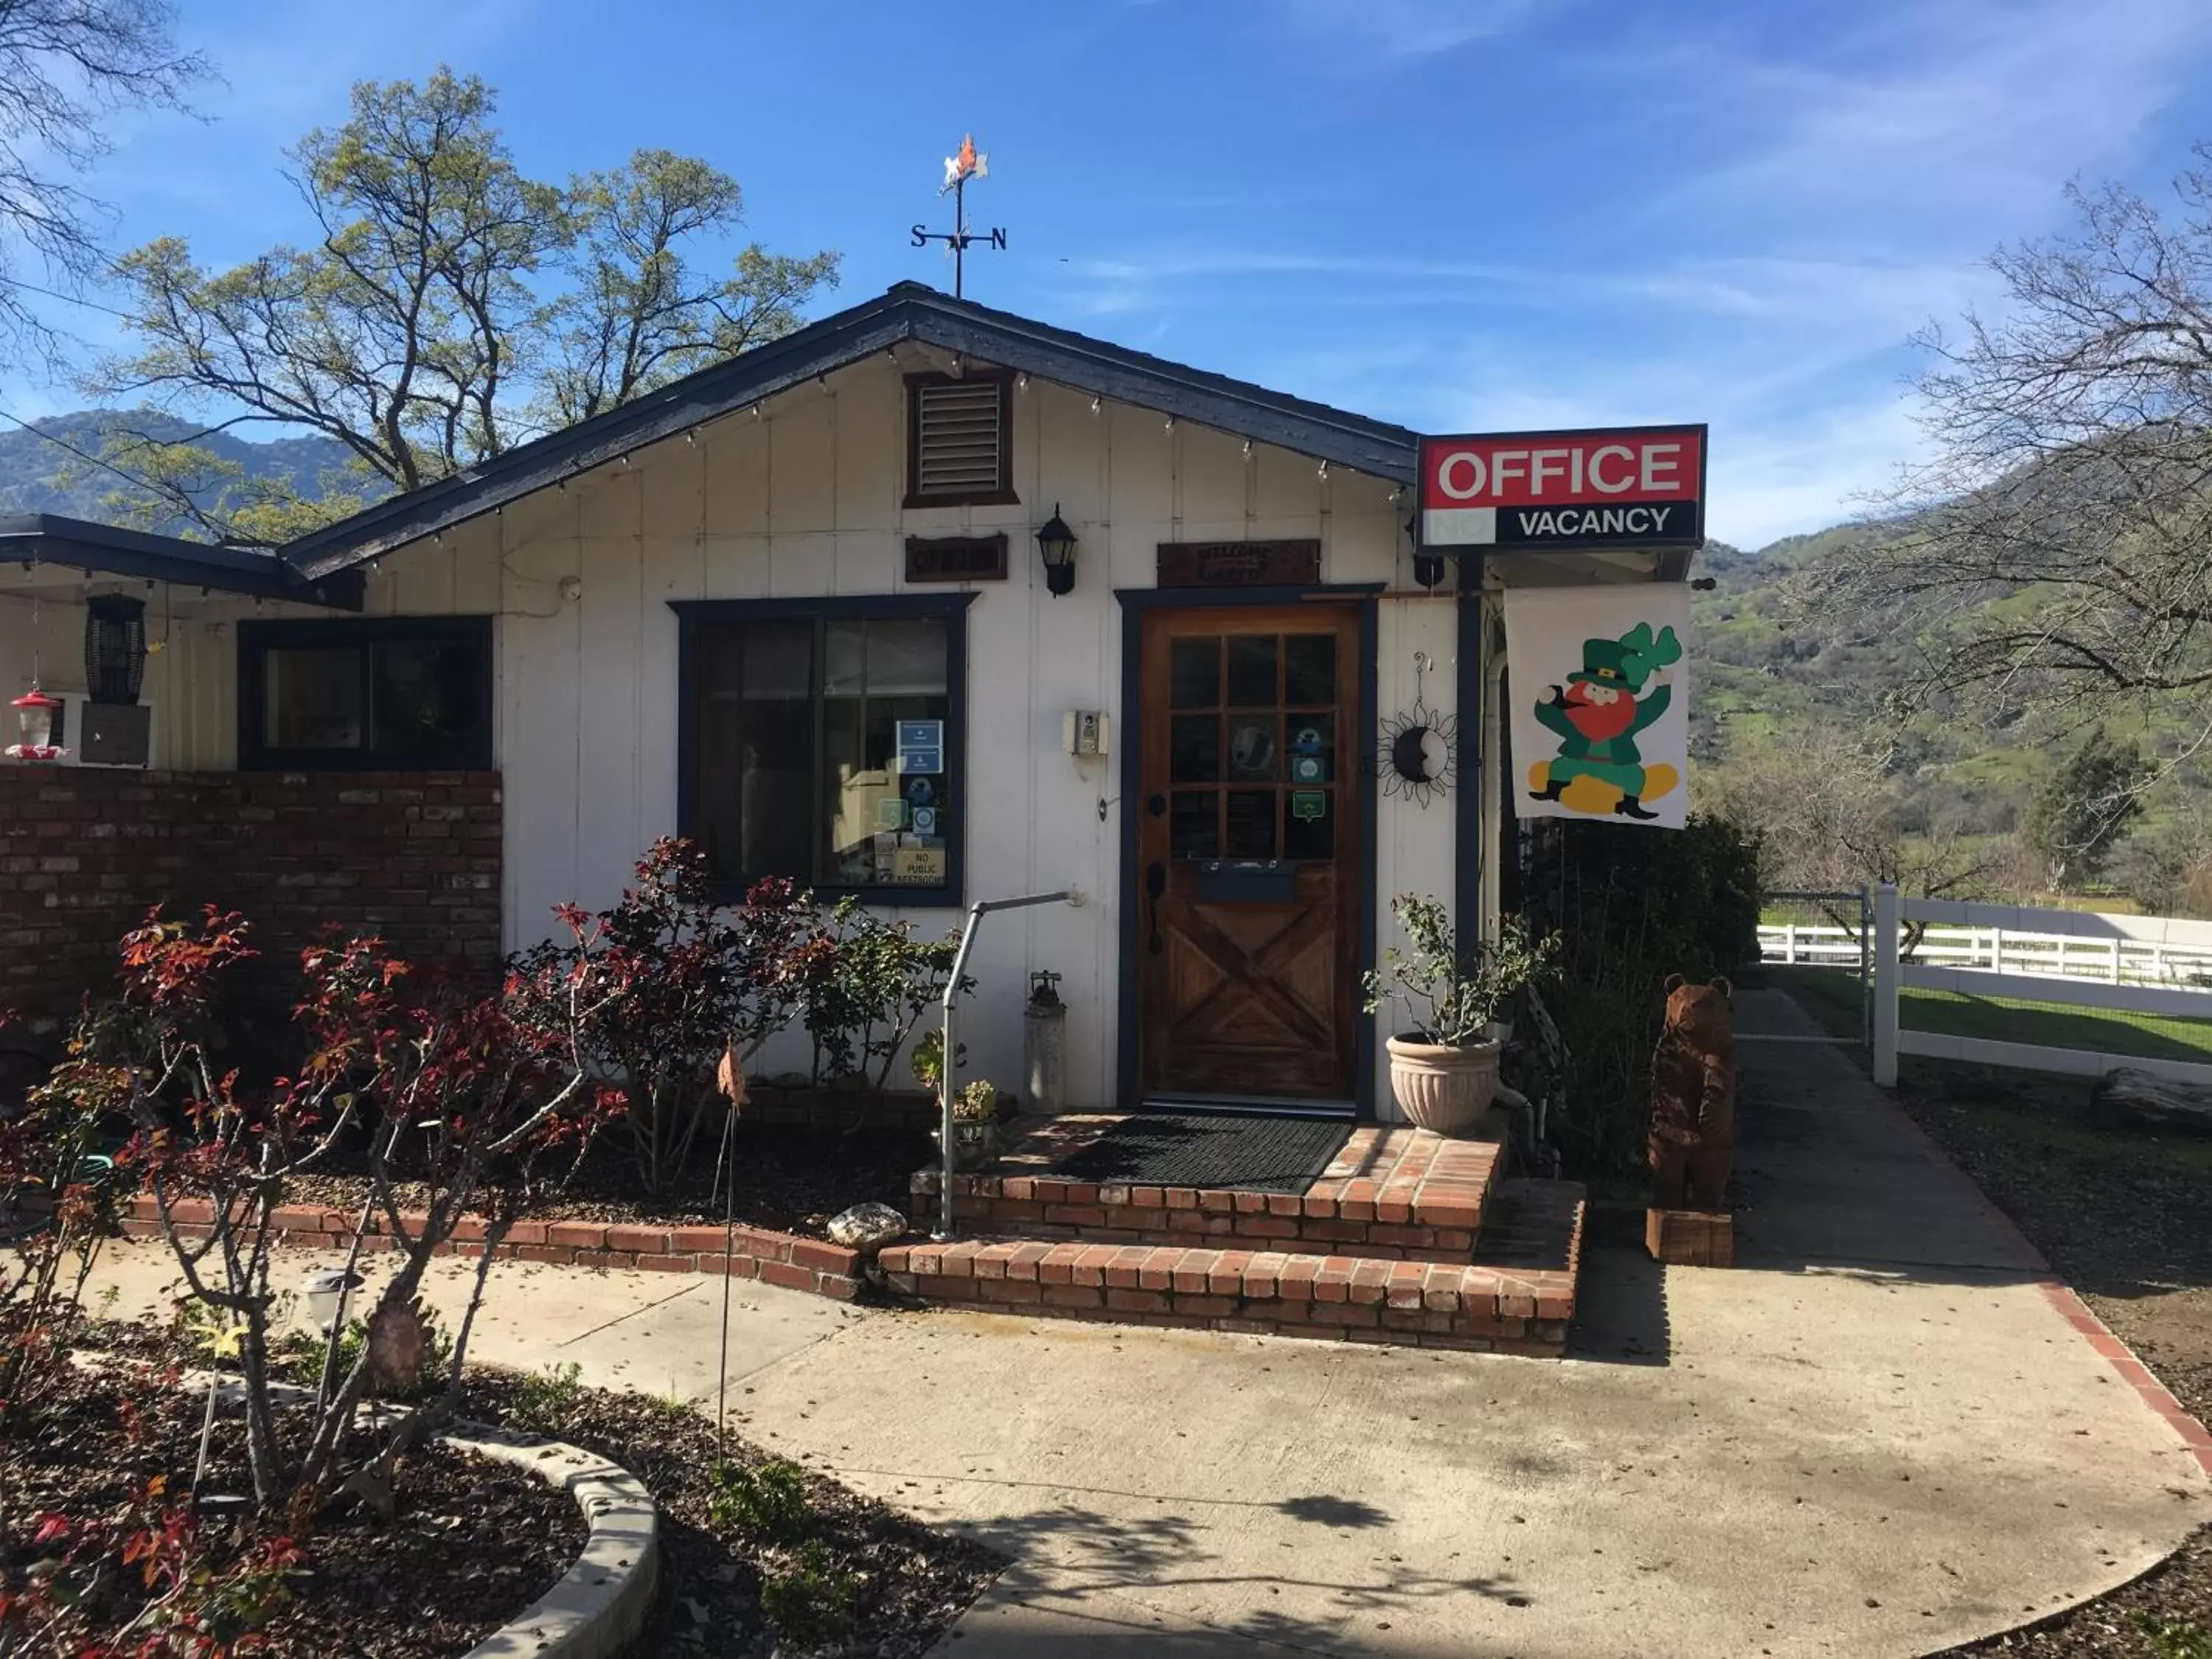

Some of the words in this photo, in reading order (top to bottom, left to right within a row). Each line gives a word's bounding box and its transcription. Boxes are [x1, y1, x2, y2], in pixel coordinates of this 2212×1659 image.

[911, 224, 926, 247] S
[992, 227, 1006, 250] N
[1438, 443, 1681, 500] OFFICE
[1518, 507, 1672, 536] VACANCY
[908, 863, 936, 874] PUBLIC
[916, 853, 928, 862] NO
